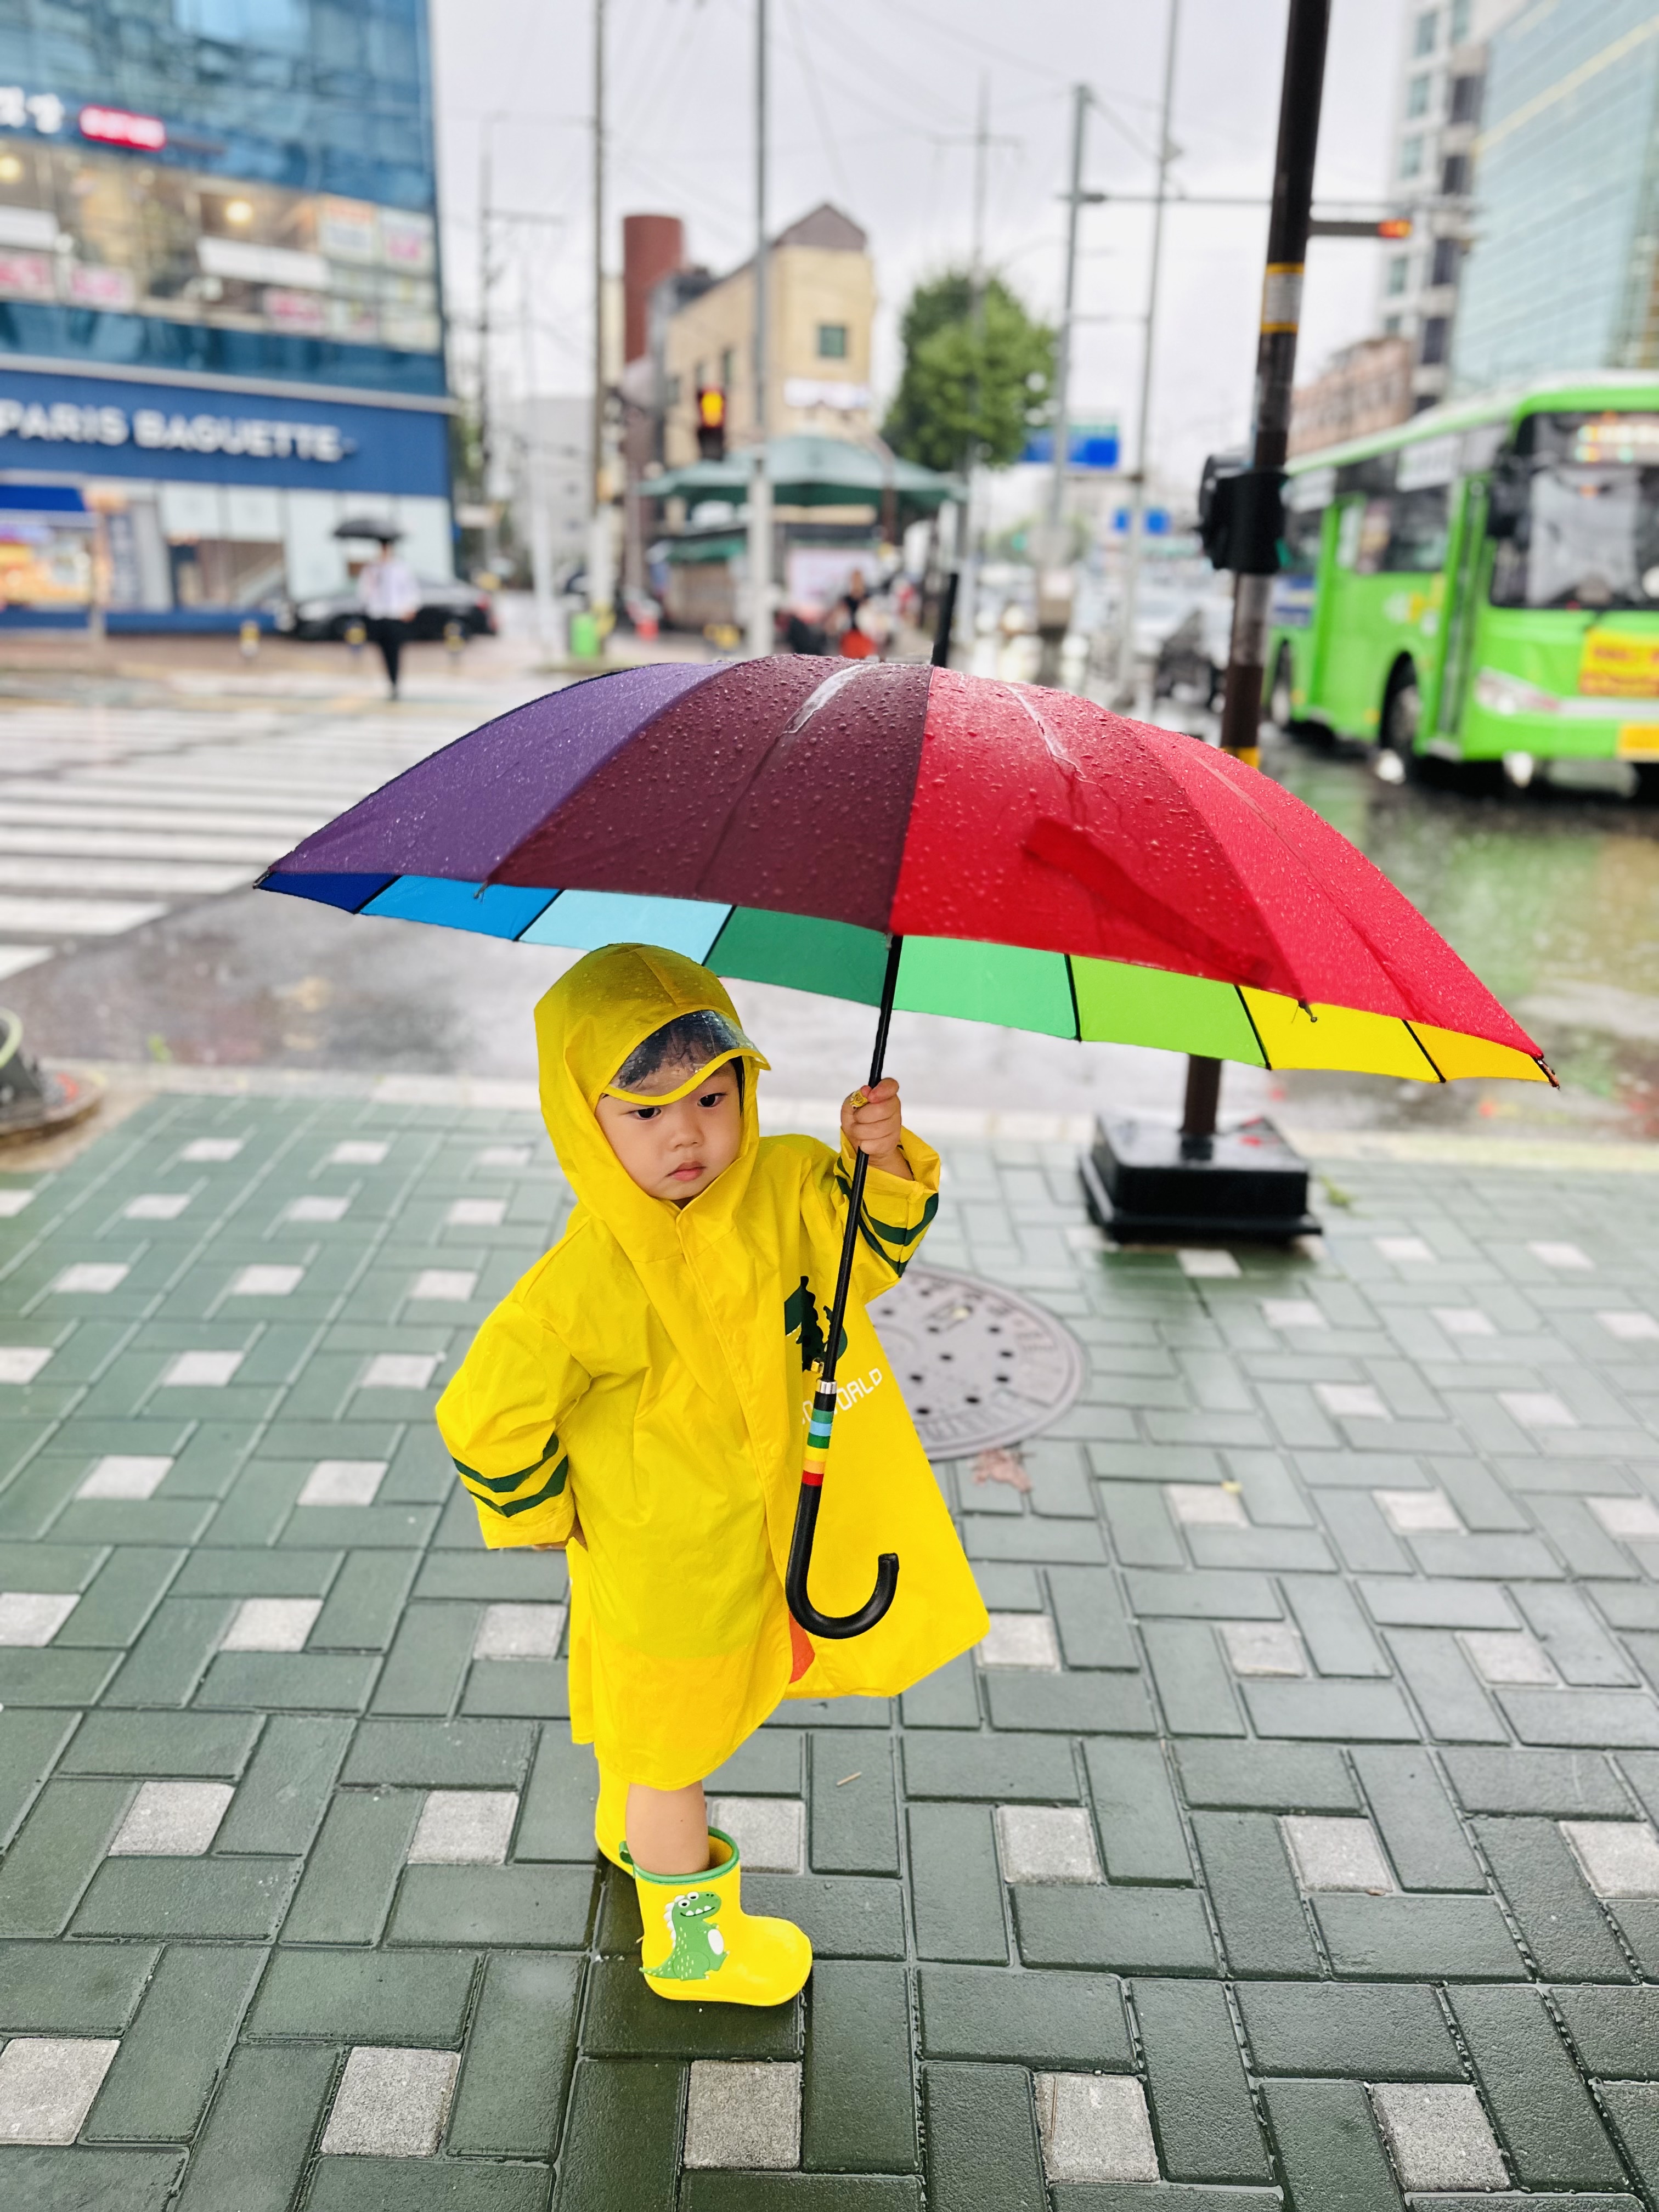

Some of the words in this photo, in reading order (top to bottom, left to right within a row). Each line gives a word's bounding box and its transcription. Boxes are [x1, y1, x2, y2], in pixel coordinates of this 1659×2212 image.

[0, 398, 129, 446] PARIS
[133, 409, 343, 462] BAGUETTE
[834, 1368, 883, 1415] ORLD
